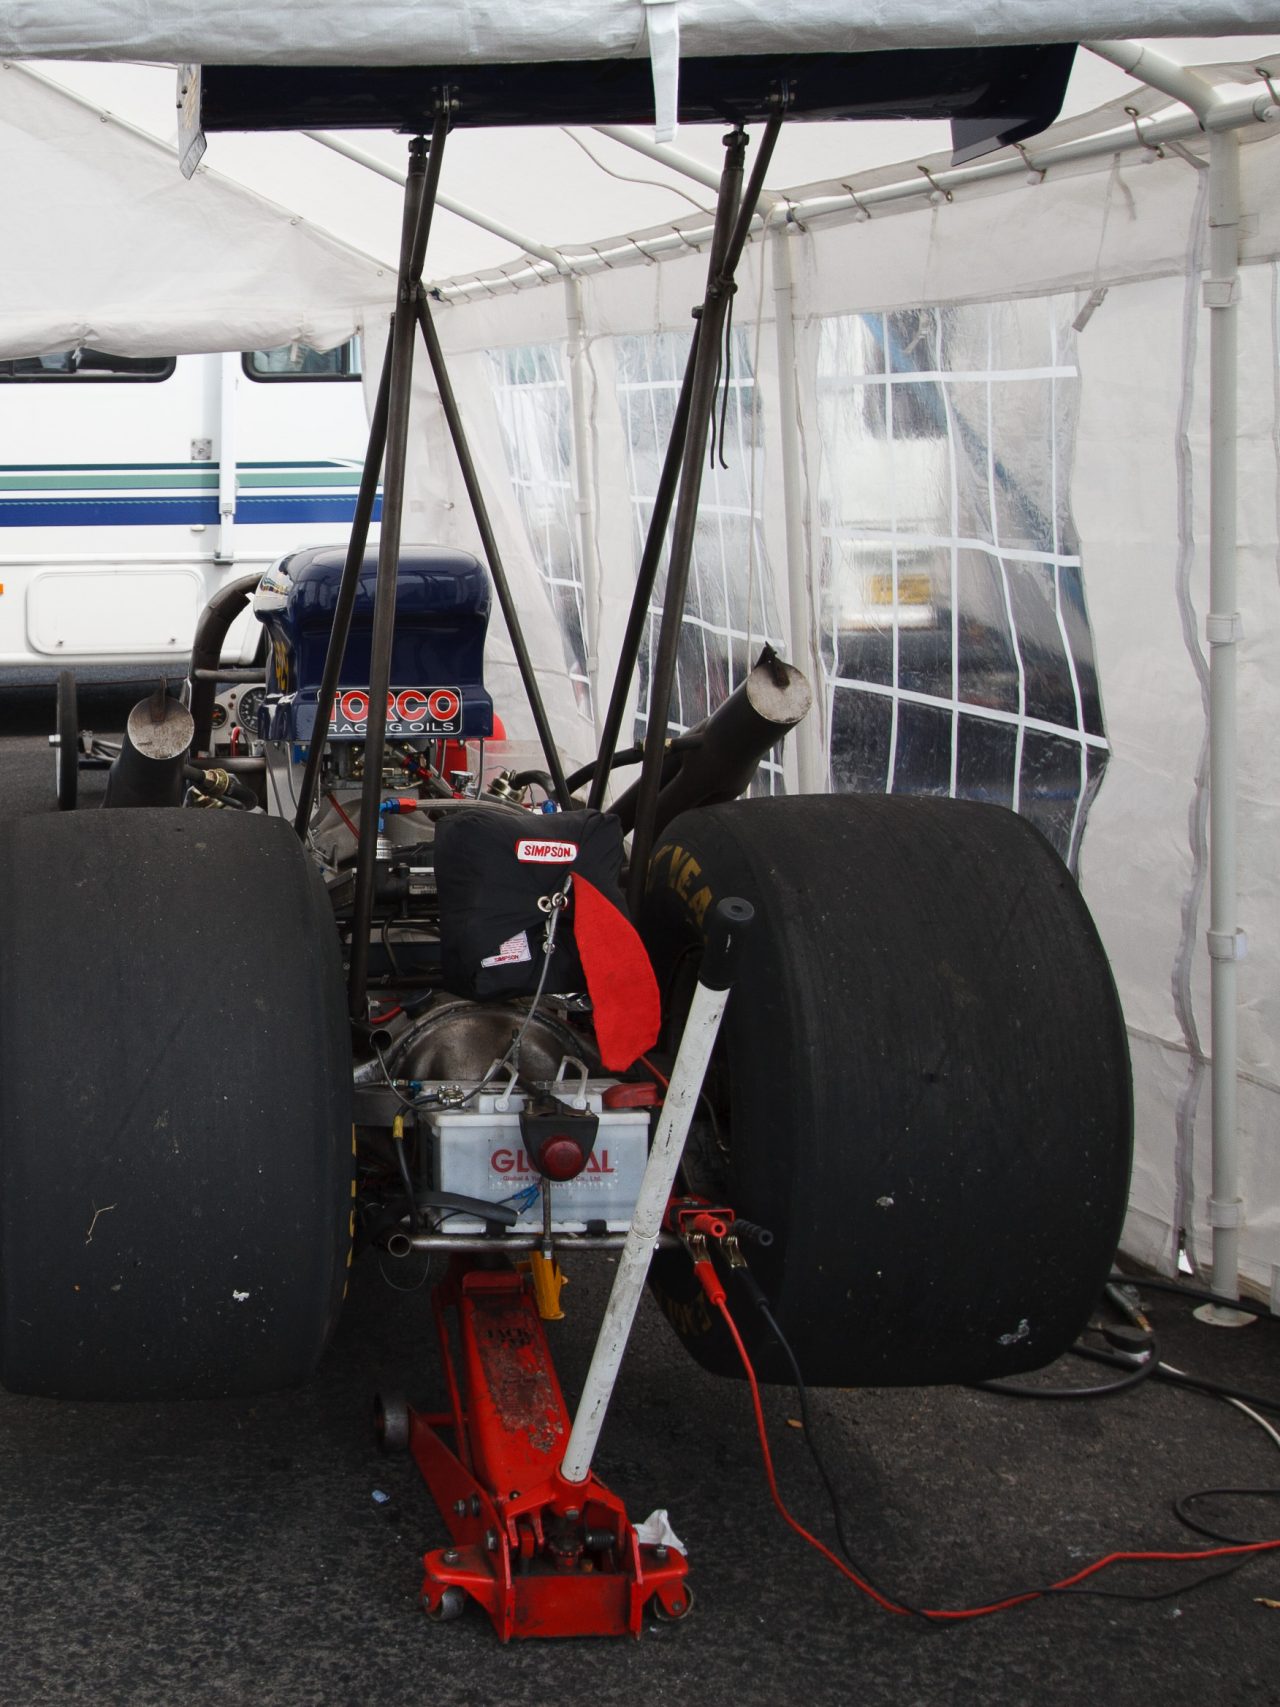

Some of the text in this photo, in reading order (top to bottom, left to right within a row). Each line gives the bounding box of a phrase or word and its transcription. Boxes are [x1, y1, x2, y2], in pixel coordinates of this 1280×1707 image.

[328, 722, 455, 733] RACG OILS
[524, 845, 572, 858] SIMPSON
[491, 1149, 615, 1173] GLAL
